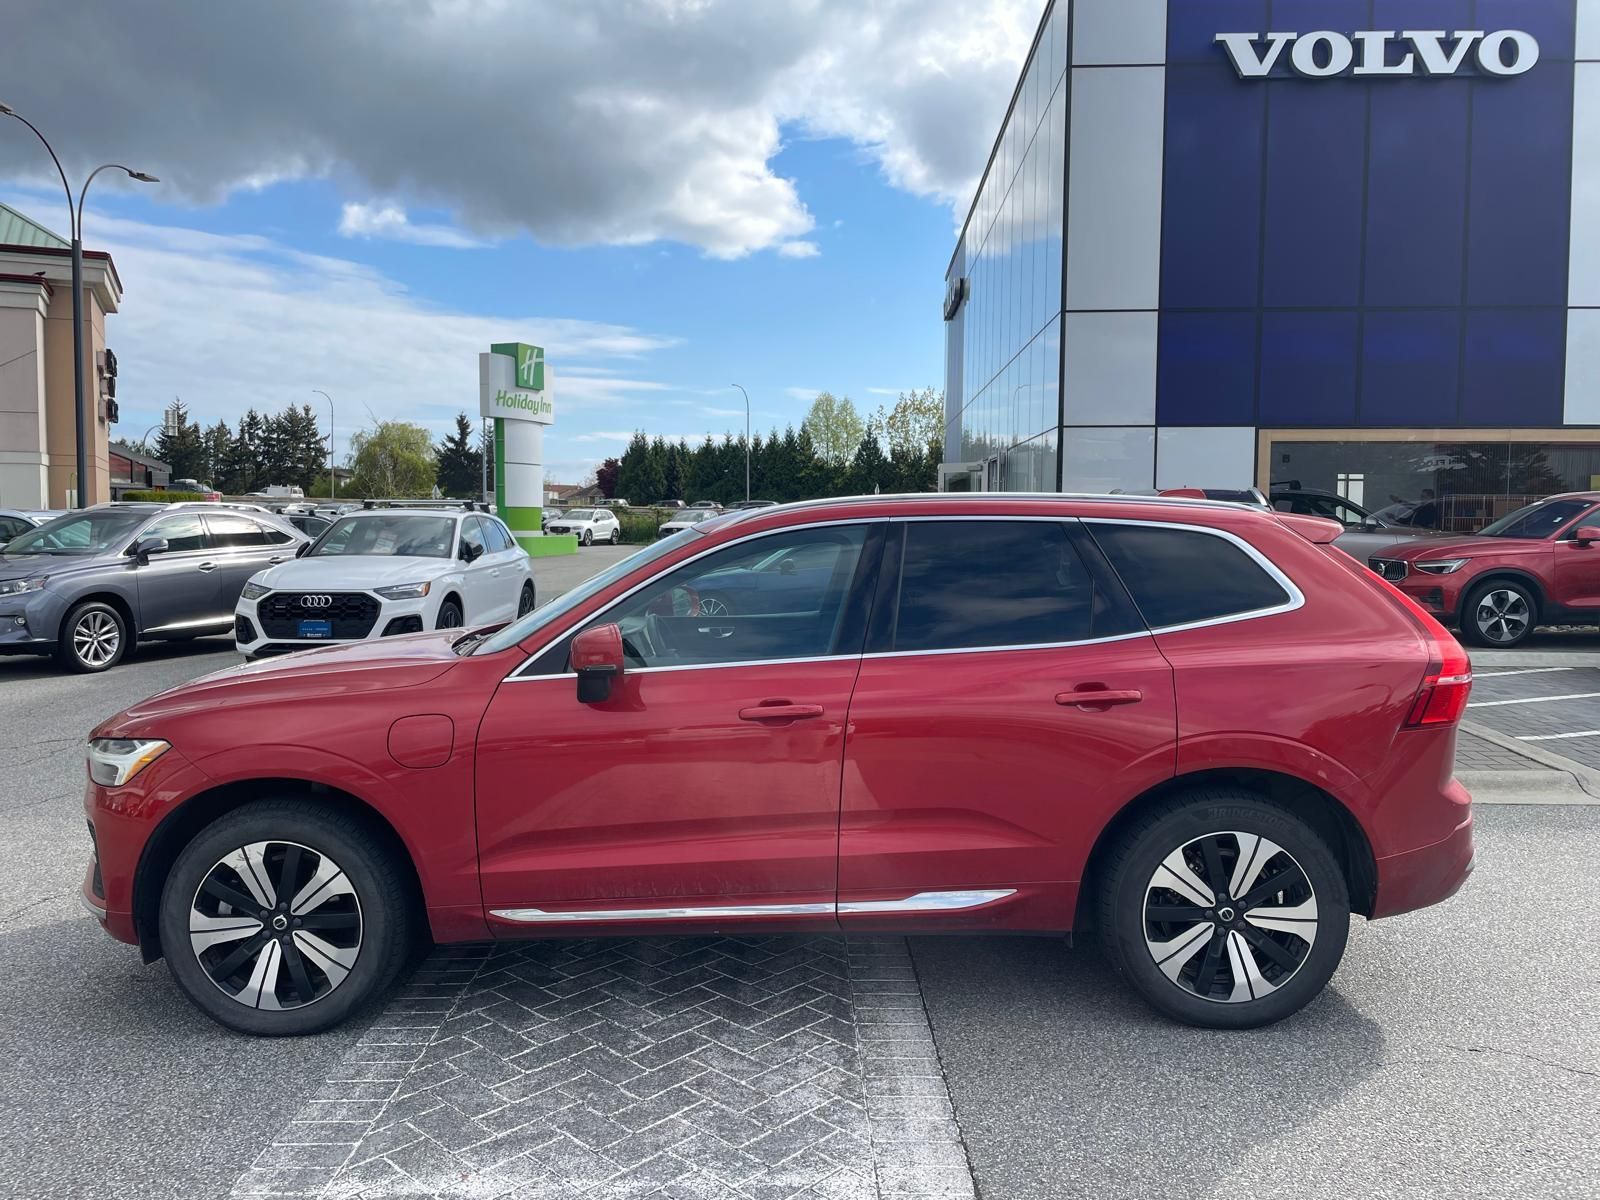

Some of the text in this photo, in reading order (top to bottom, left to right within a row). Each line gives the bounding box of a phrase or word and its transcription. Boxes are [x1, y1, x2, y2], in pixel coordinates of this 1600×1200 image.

[1214, 29, 1540, 78] VOLVO
[496, 390, 552, 416] Holiday Inn
